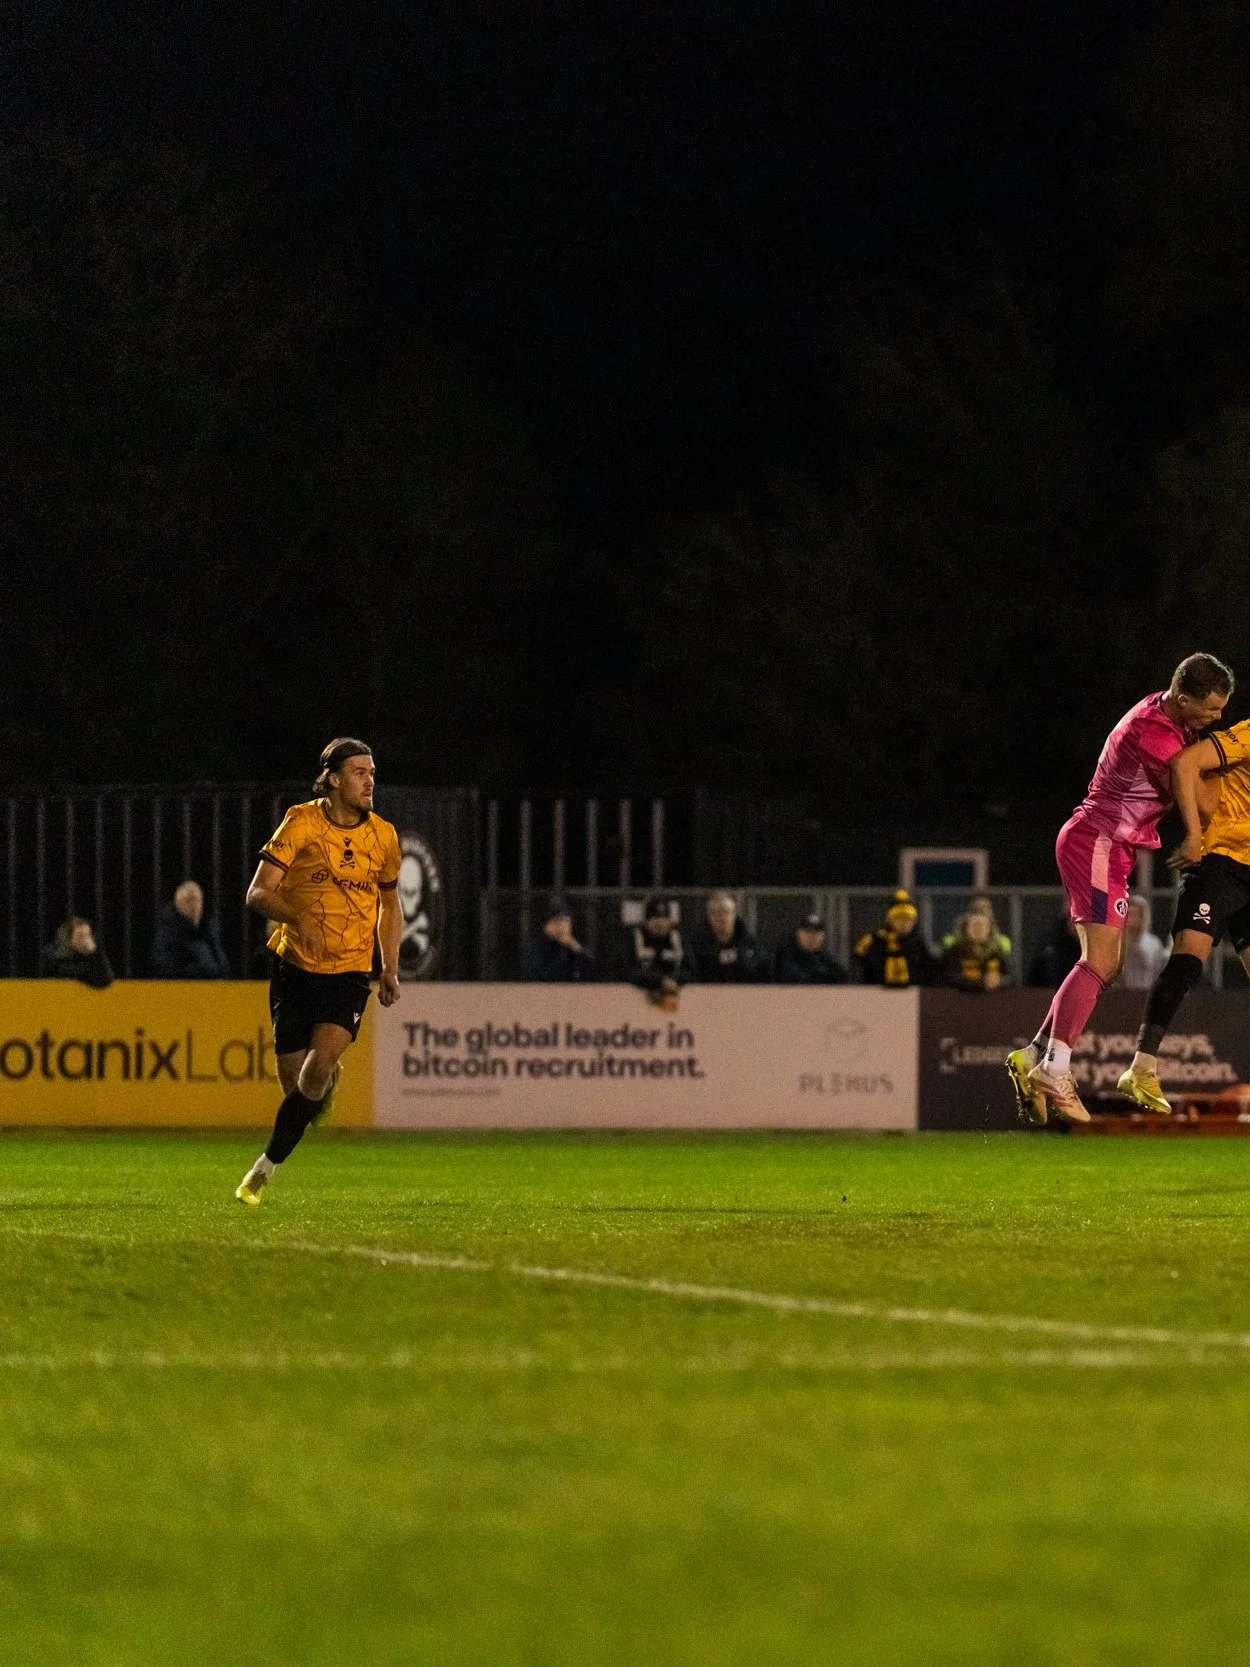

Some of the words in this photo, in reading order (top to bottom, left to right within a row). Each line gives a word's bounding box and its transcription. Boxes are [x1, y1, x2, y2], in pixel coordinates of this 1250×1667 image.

[403, 1022, 459, 1047] The
[466, 1021, 558, 1054] global
[566, 1021, 660, 1047] leader
[668, 1021, 695, 1047] in
[403, 1051, 508, 1077] bitcoin
[516, 1052, 705, 1078] recruitment.
